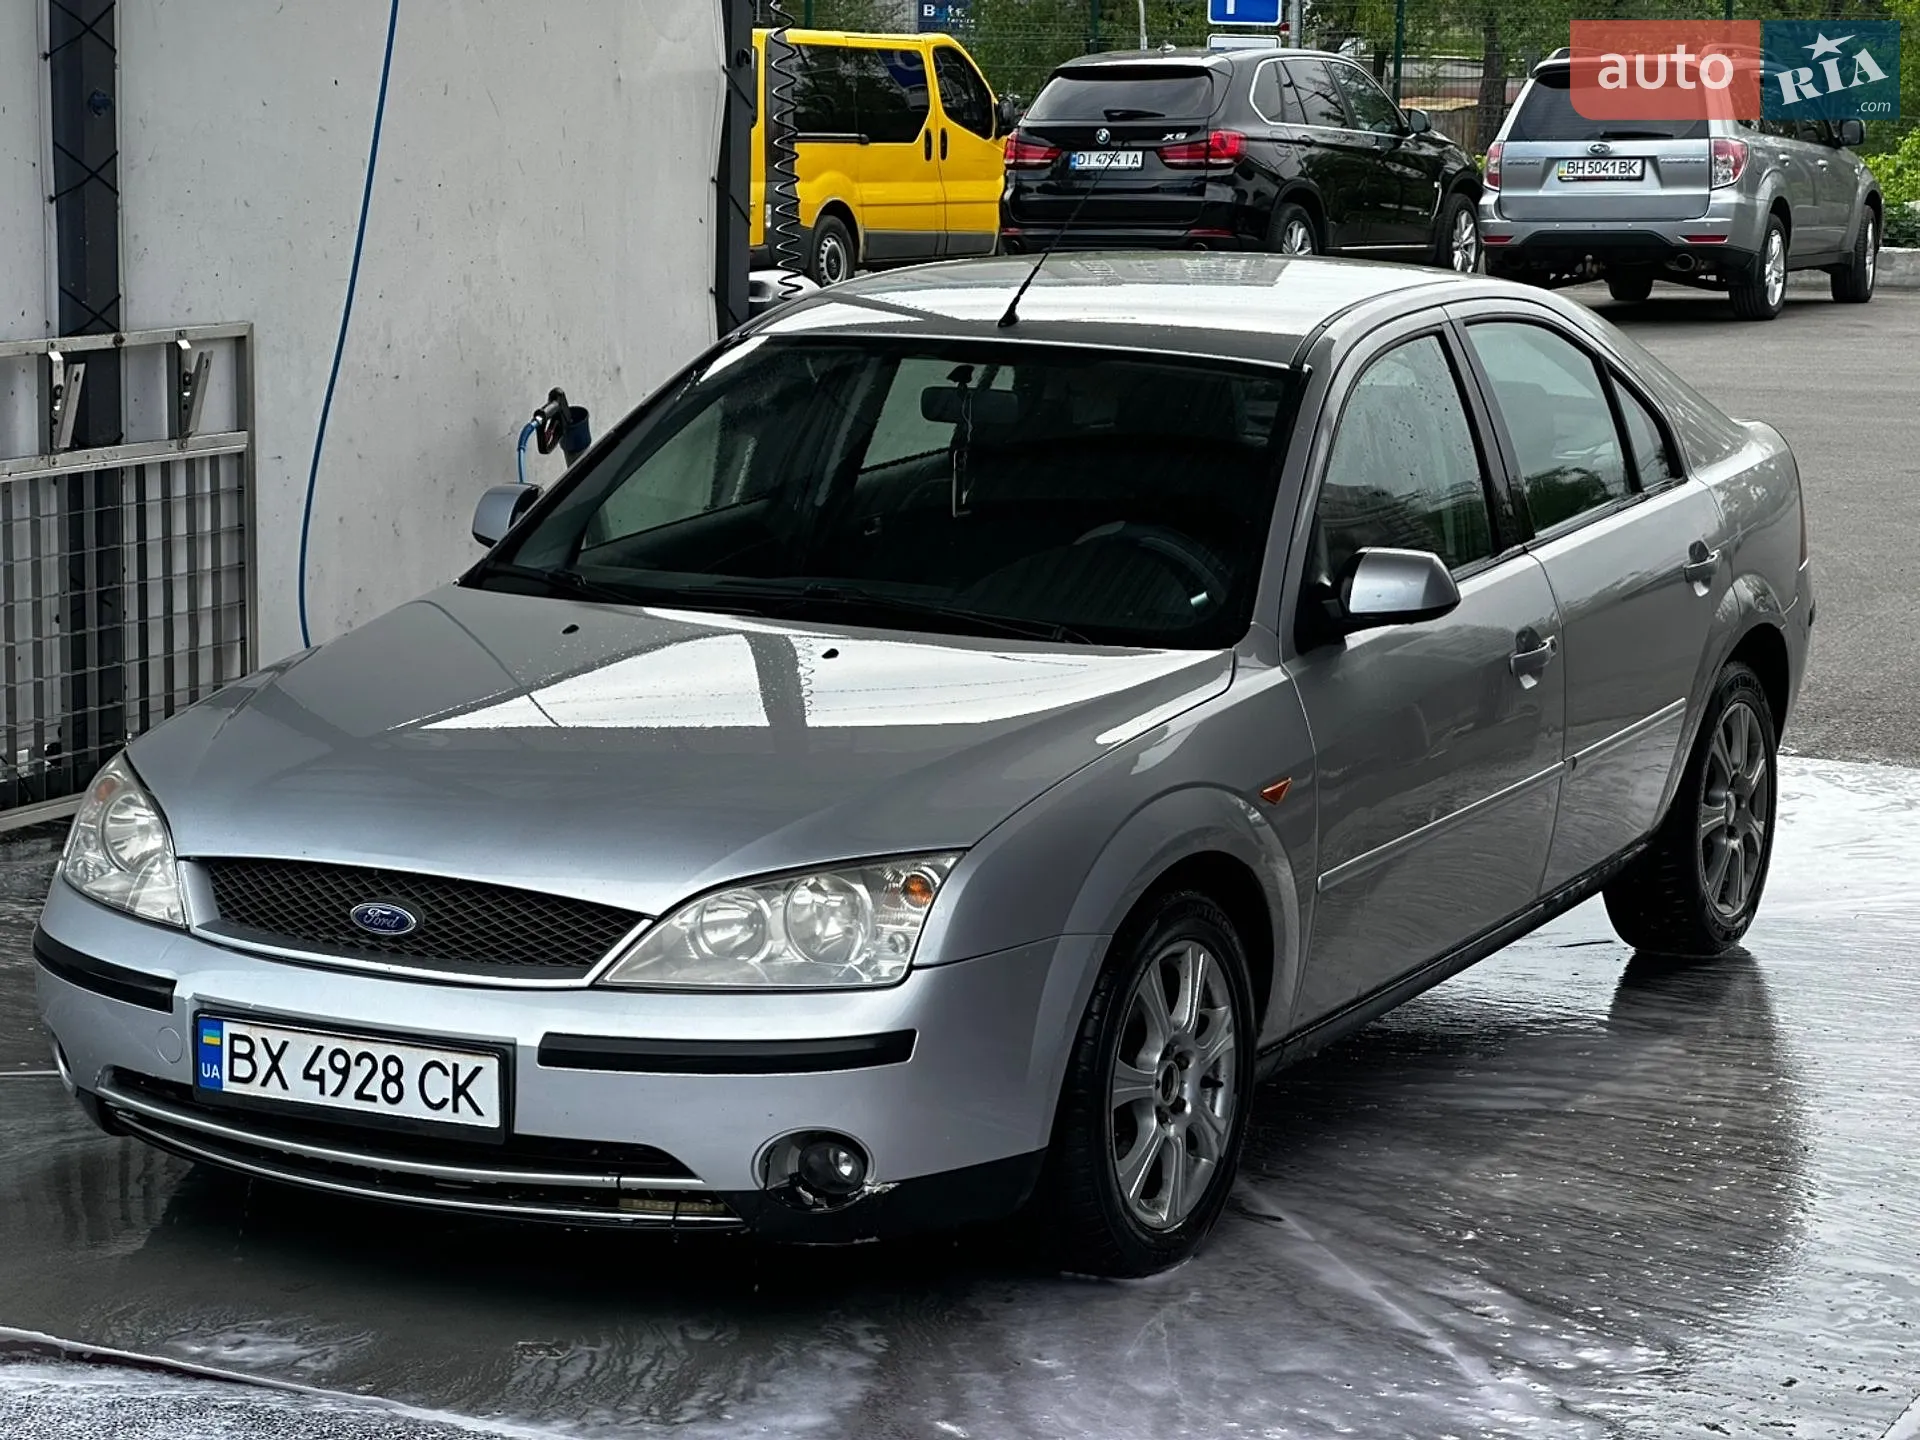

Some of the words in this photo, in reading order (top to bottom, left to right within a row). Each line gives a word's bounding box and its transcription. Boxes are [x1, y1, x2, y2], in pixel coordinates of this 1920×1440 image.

[1566, 161, 1585, 174] BH
[1587, 161, 1617, 174] 5041
[1619, 161, 1638, 174] BK
[363, 908, 400, 928] Ford
[202, 1062, 221, 1080] UA
[228, 1033, 290, 1091] BX
[302, 1044, 405, 1105] 4928
[418, 1060, 485, 1117] CK
